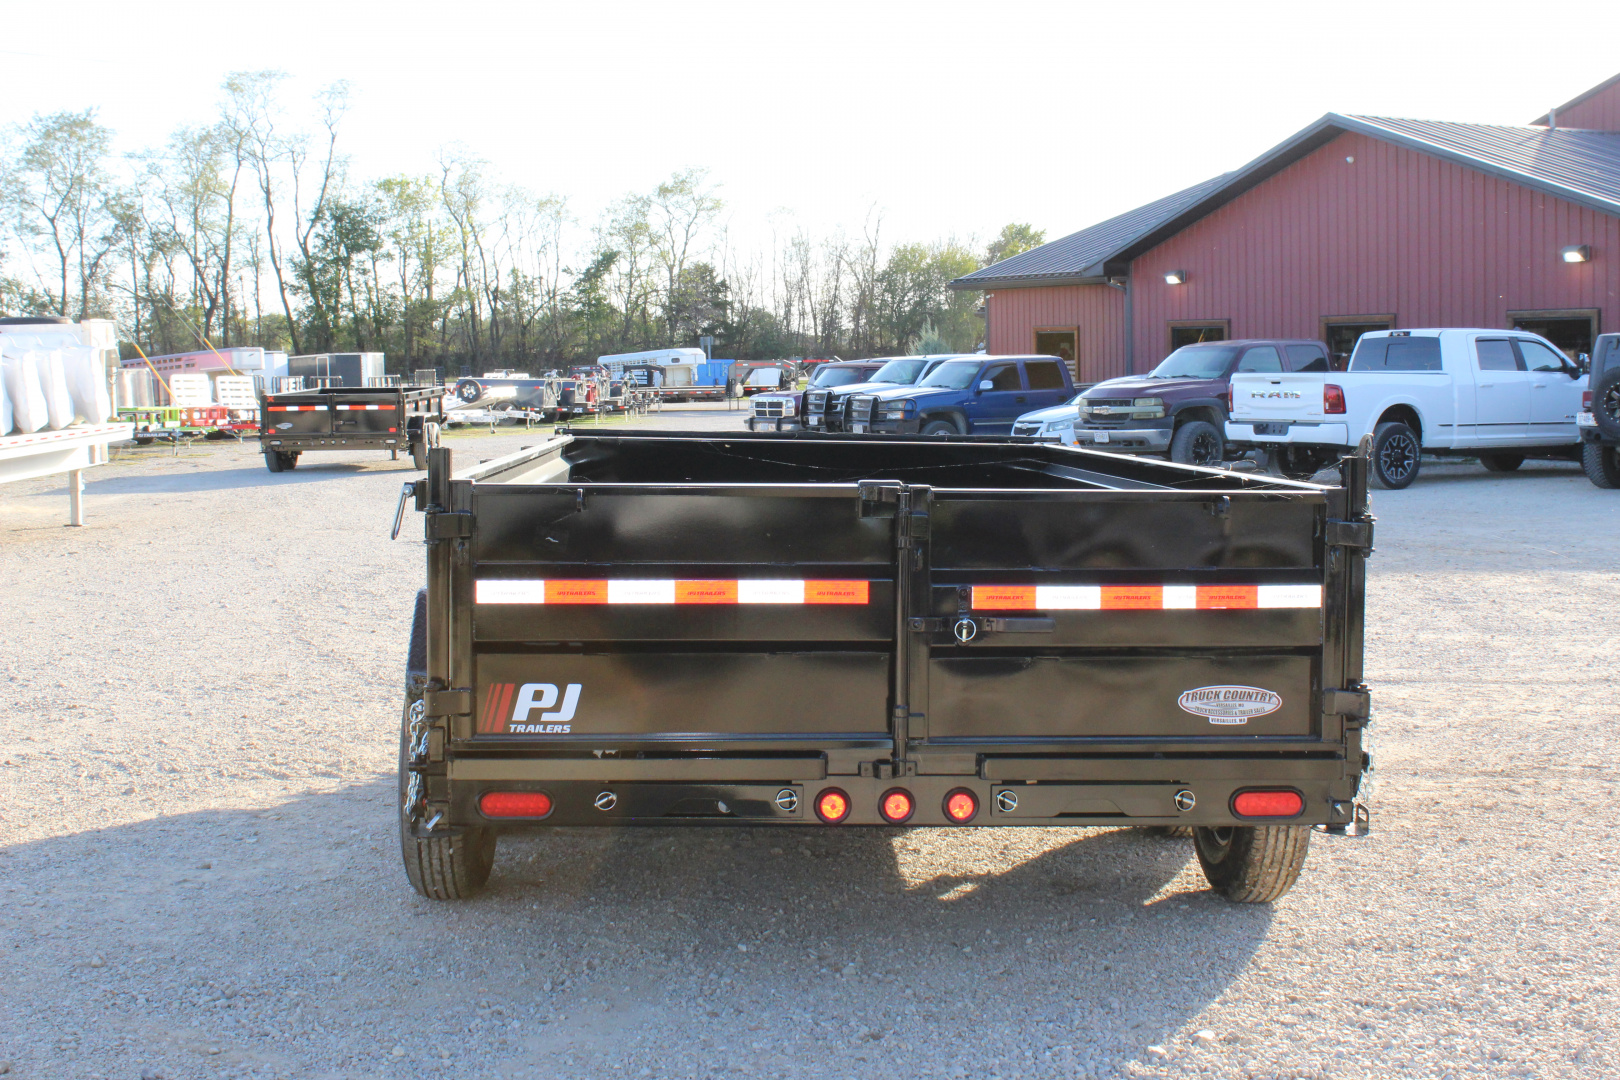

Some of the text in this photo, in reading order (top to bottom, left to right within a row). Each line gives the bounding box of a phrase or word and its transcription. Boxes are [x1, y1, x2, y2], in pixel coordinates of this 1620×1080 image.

[1251, 390, 1301, 399] RAM
[1185, 690, 1276, 703] TRUCK COUNTRY
[512, 683, 583, 722] PJ
[1254, 706, 1266, 714] SALES
[509, 724, 571, 734] TRAILERS
